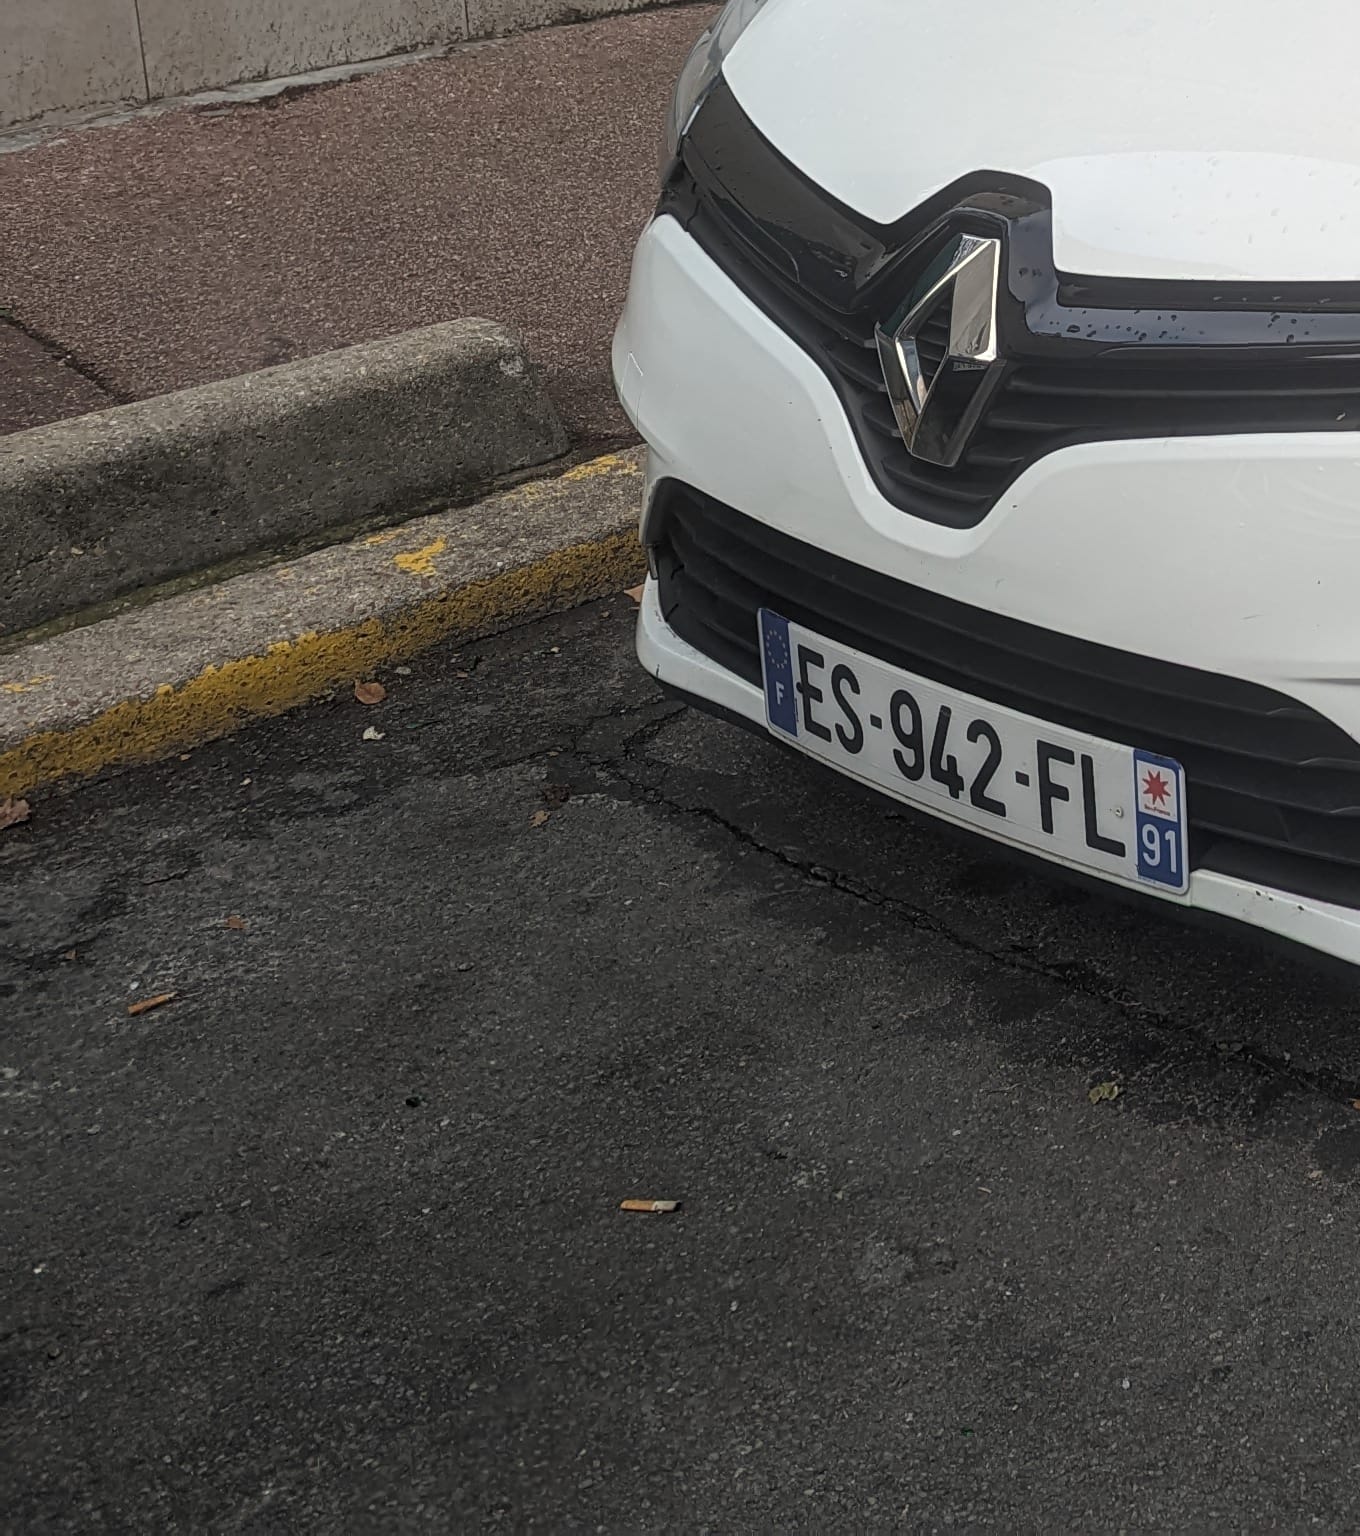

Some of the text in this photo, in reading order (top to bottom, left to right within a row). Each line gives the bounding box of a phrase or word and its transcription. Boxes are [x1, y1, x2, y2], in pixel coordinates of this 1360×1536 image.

[775, 681, 785, 705] F
[795, 643, 1127, 859] ES-942-FL
[1141, 823, 1178, 874] 91
